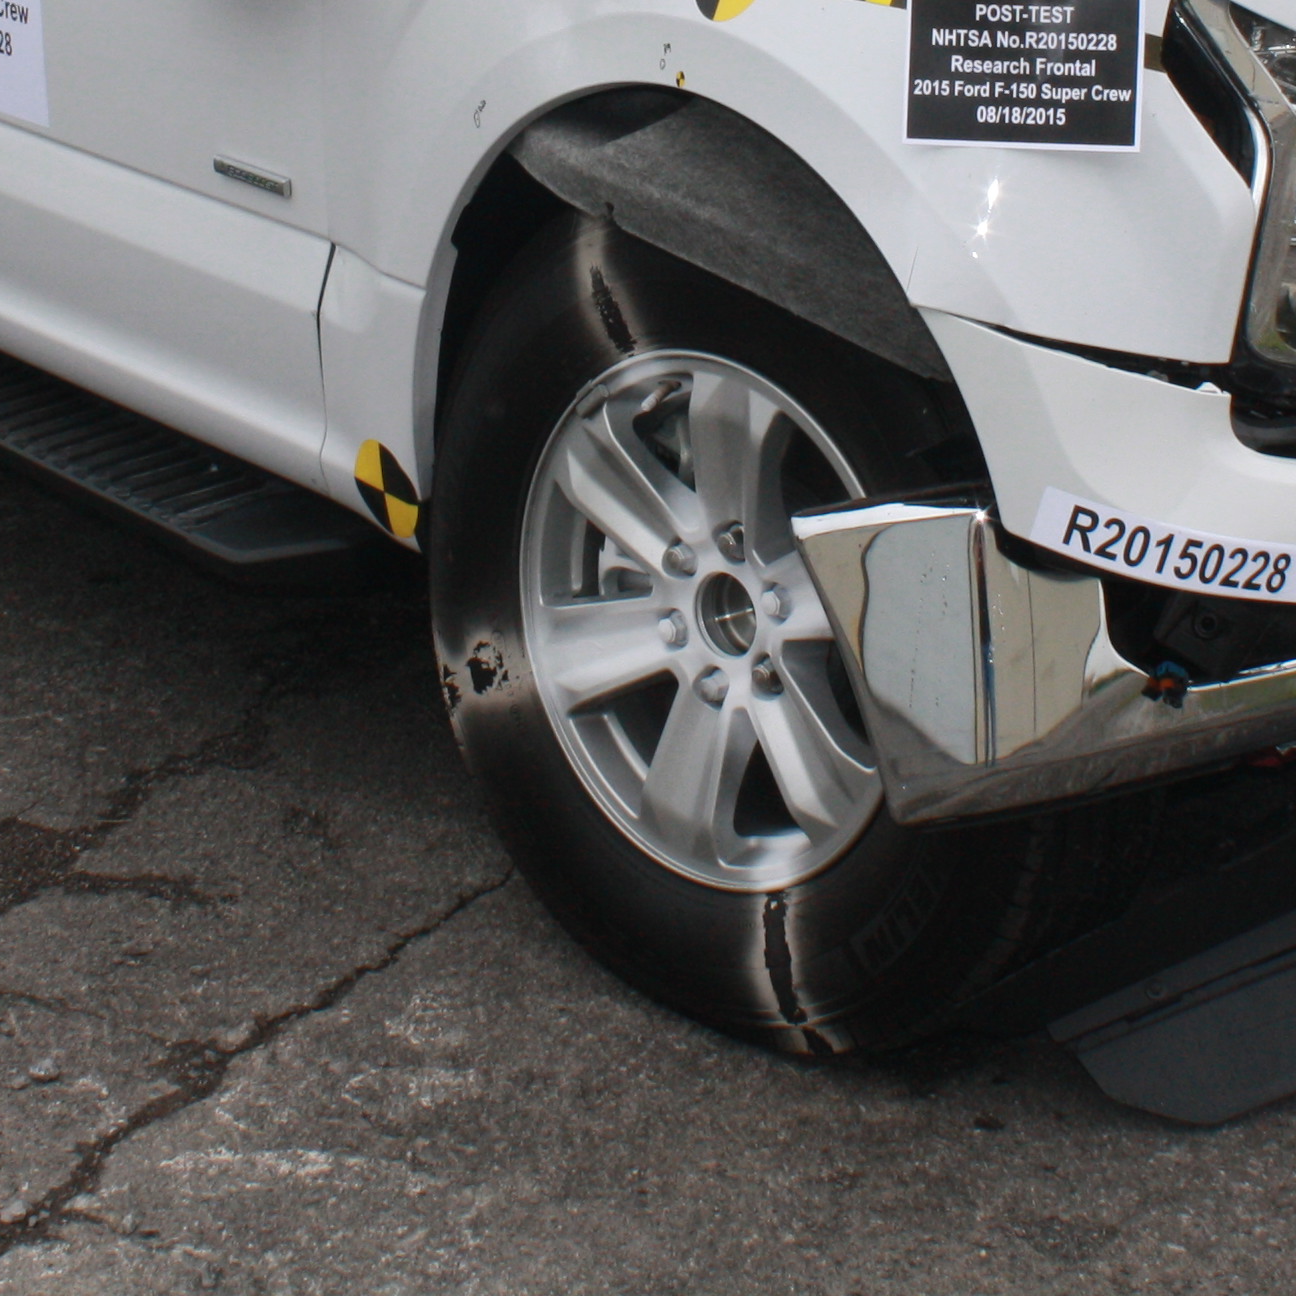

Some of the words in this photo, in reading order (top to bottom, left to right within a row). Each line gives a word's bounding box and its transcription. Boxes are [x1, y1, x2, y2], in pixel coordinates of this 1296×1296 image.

[975, 3, 1075, 24] POST-TEST
[931, 28, 992, 48] NHTSA
[951, 55, 1030, 75] Research
[1035, 58, 1096, 77] Frontal
[913, 79, 950, 96] 2015
[954, 80, 990, 98] Ford
[994, 82, 1037, 99] F-150
[1040, 83, 1086, 103] Super
[1091, 85, 1132, 102] Crew
[976, 106, 1067, 125] 08/18/2015
[1062, 504, 1292, 594] R20150228
